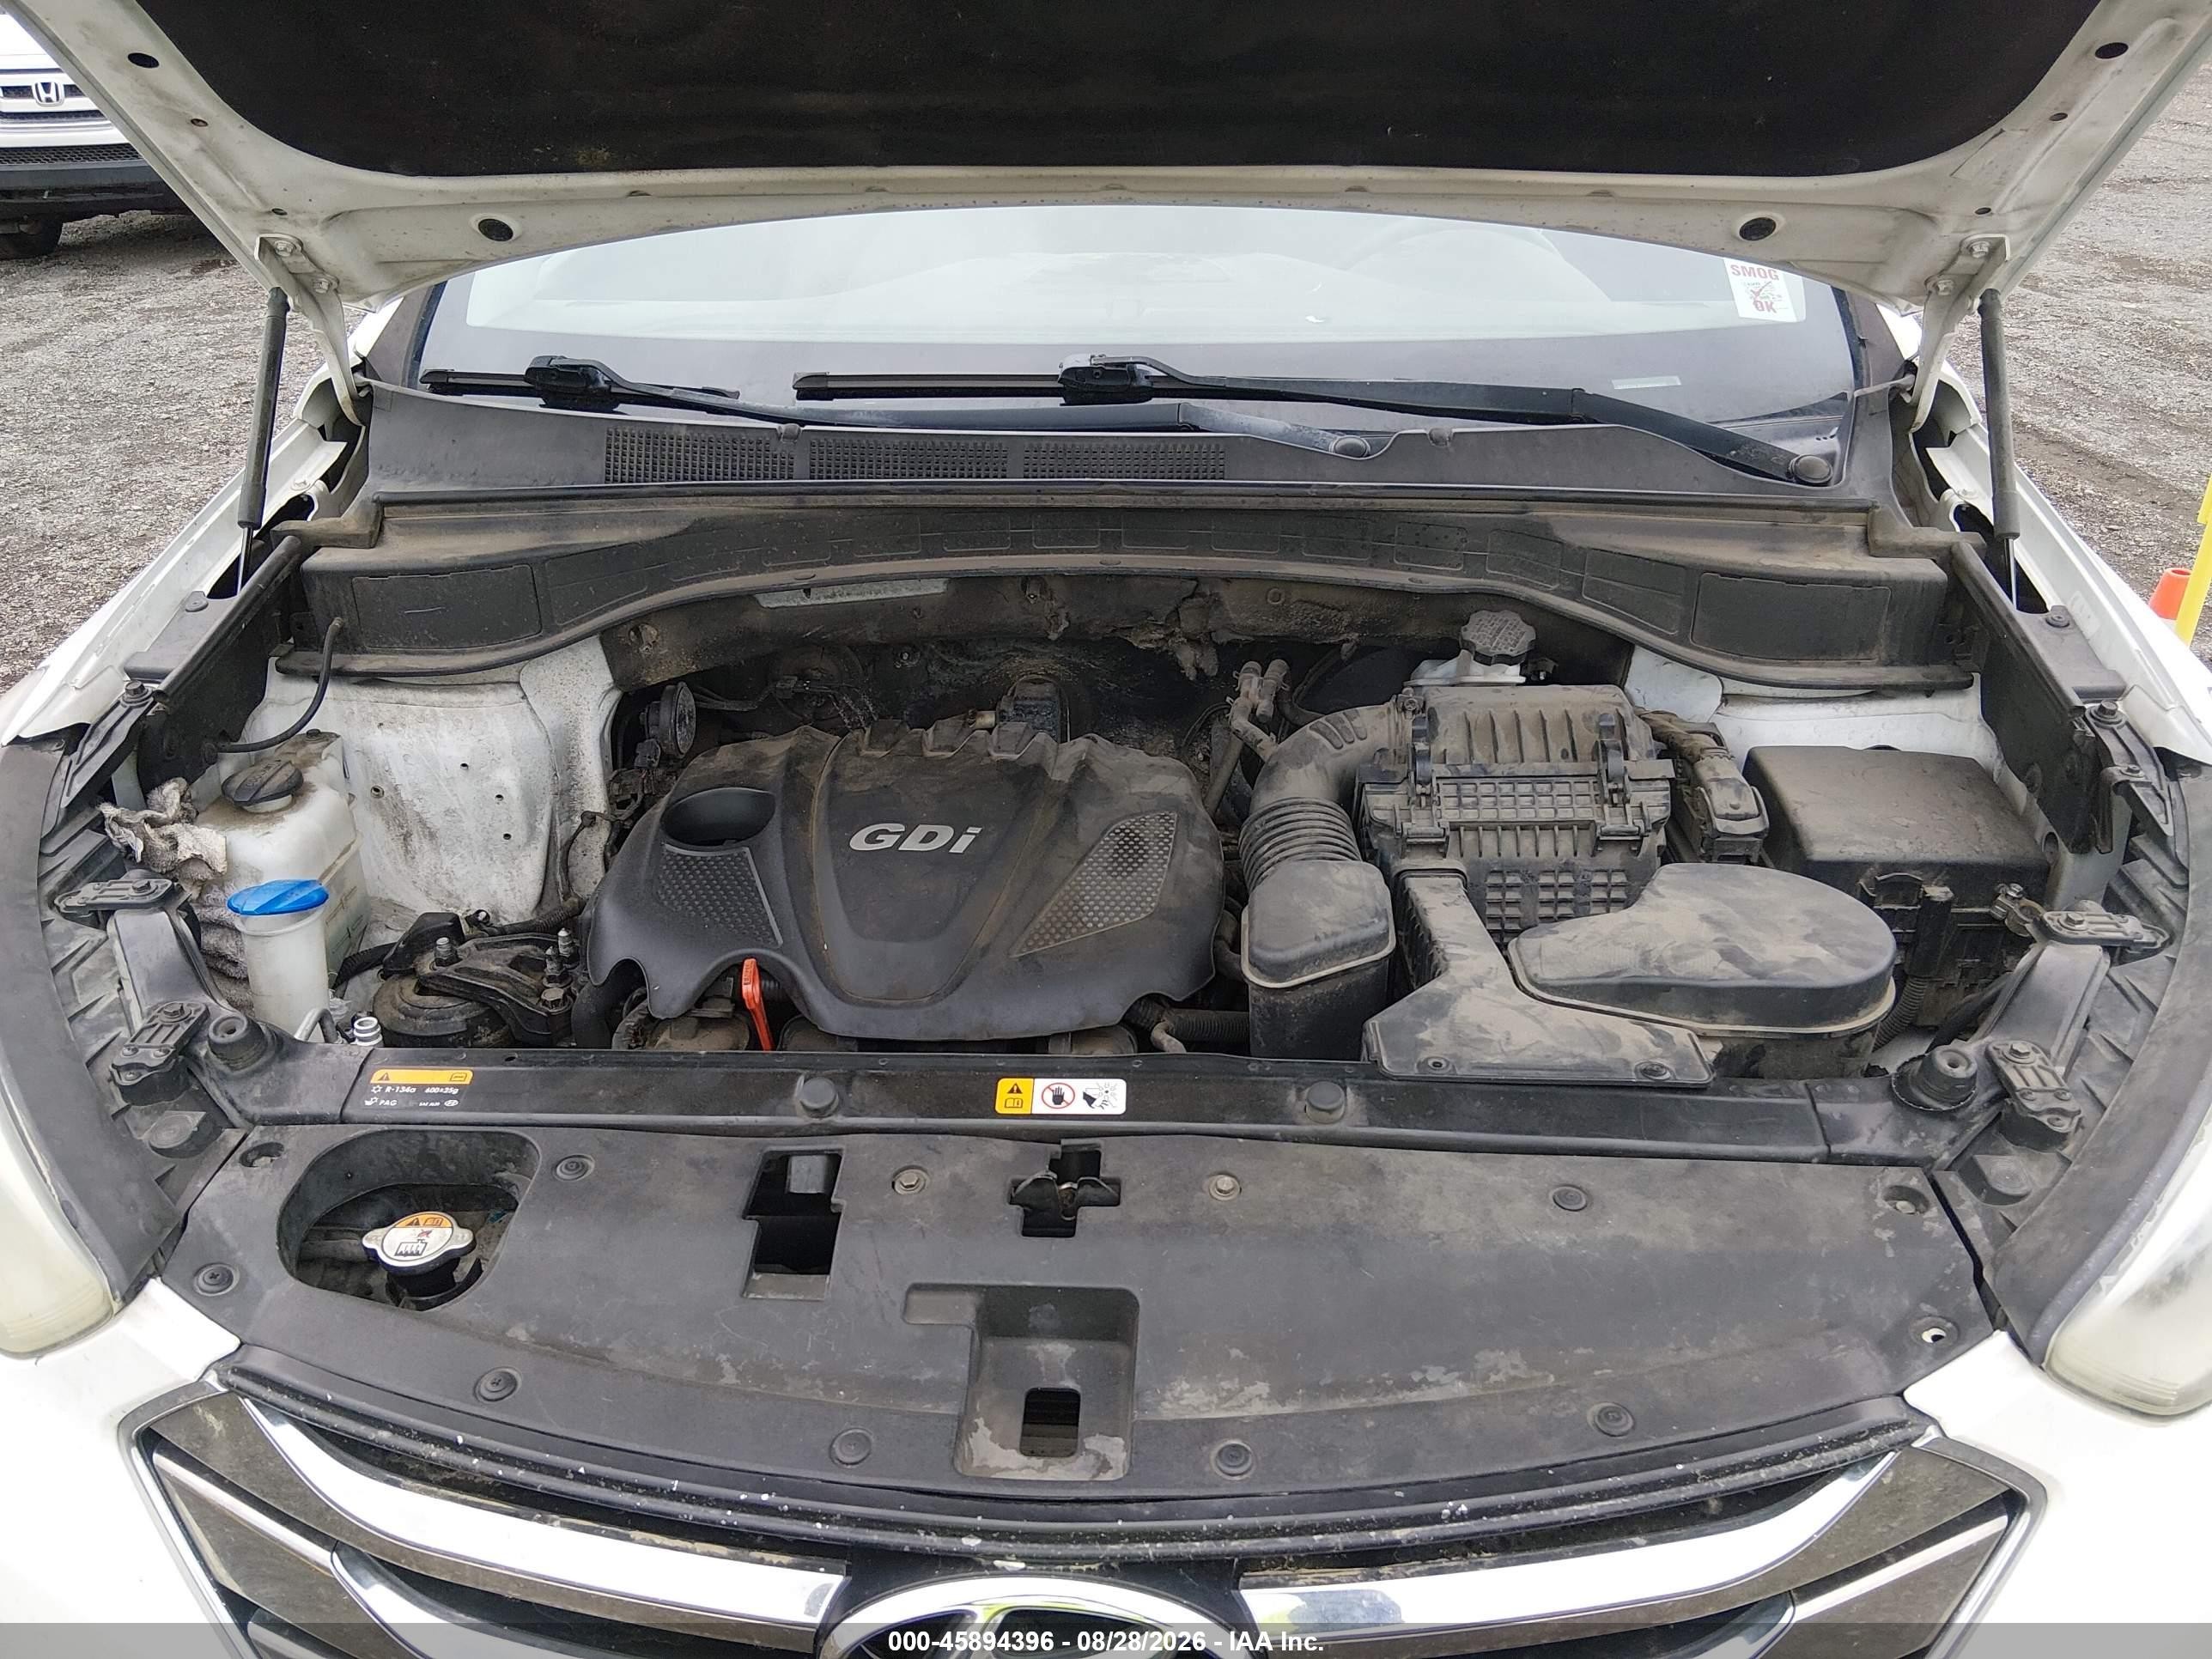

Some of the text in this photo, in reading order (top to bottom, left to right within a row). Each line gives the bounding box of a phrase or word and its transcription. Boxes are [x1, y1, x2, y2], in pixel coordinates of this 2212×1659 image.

[1730, 264, 1779, 281] SMOG
[1753, 299, 1778, 313] OK
[848, 823, 984, 854] GDi
